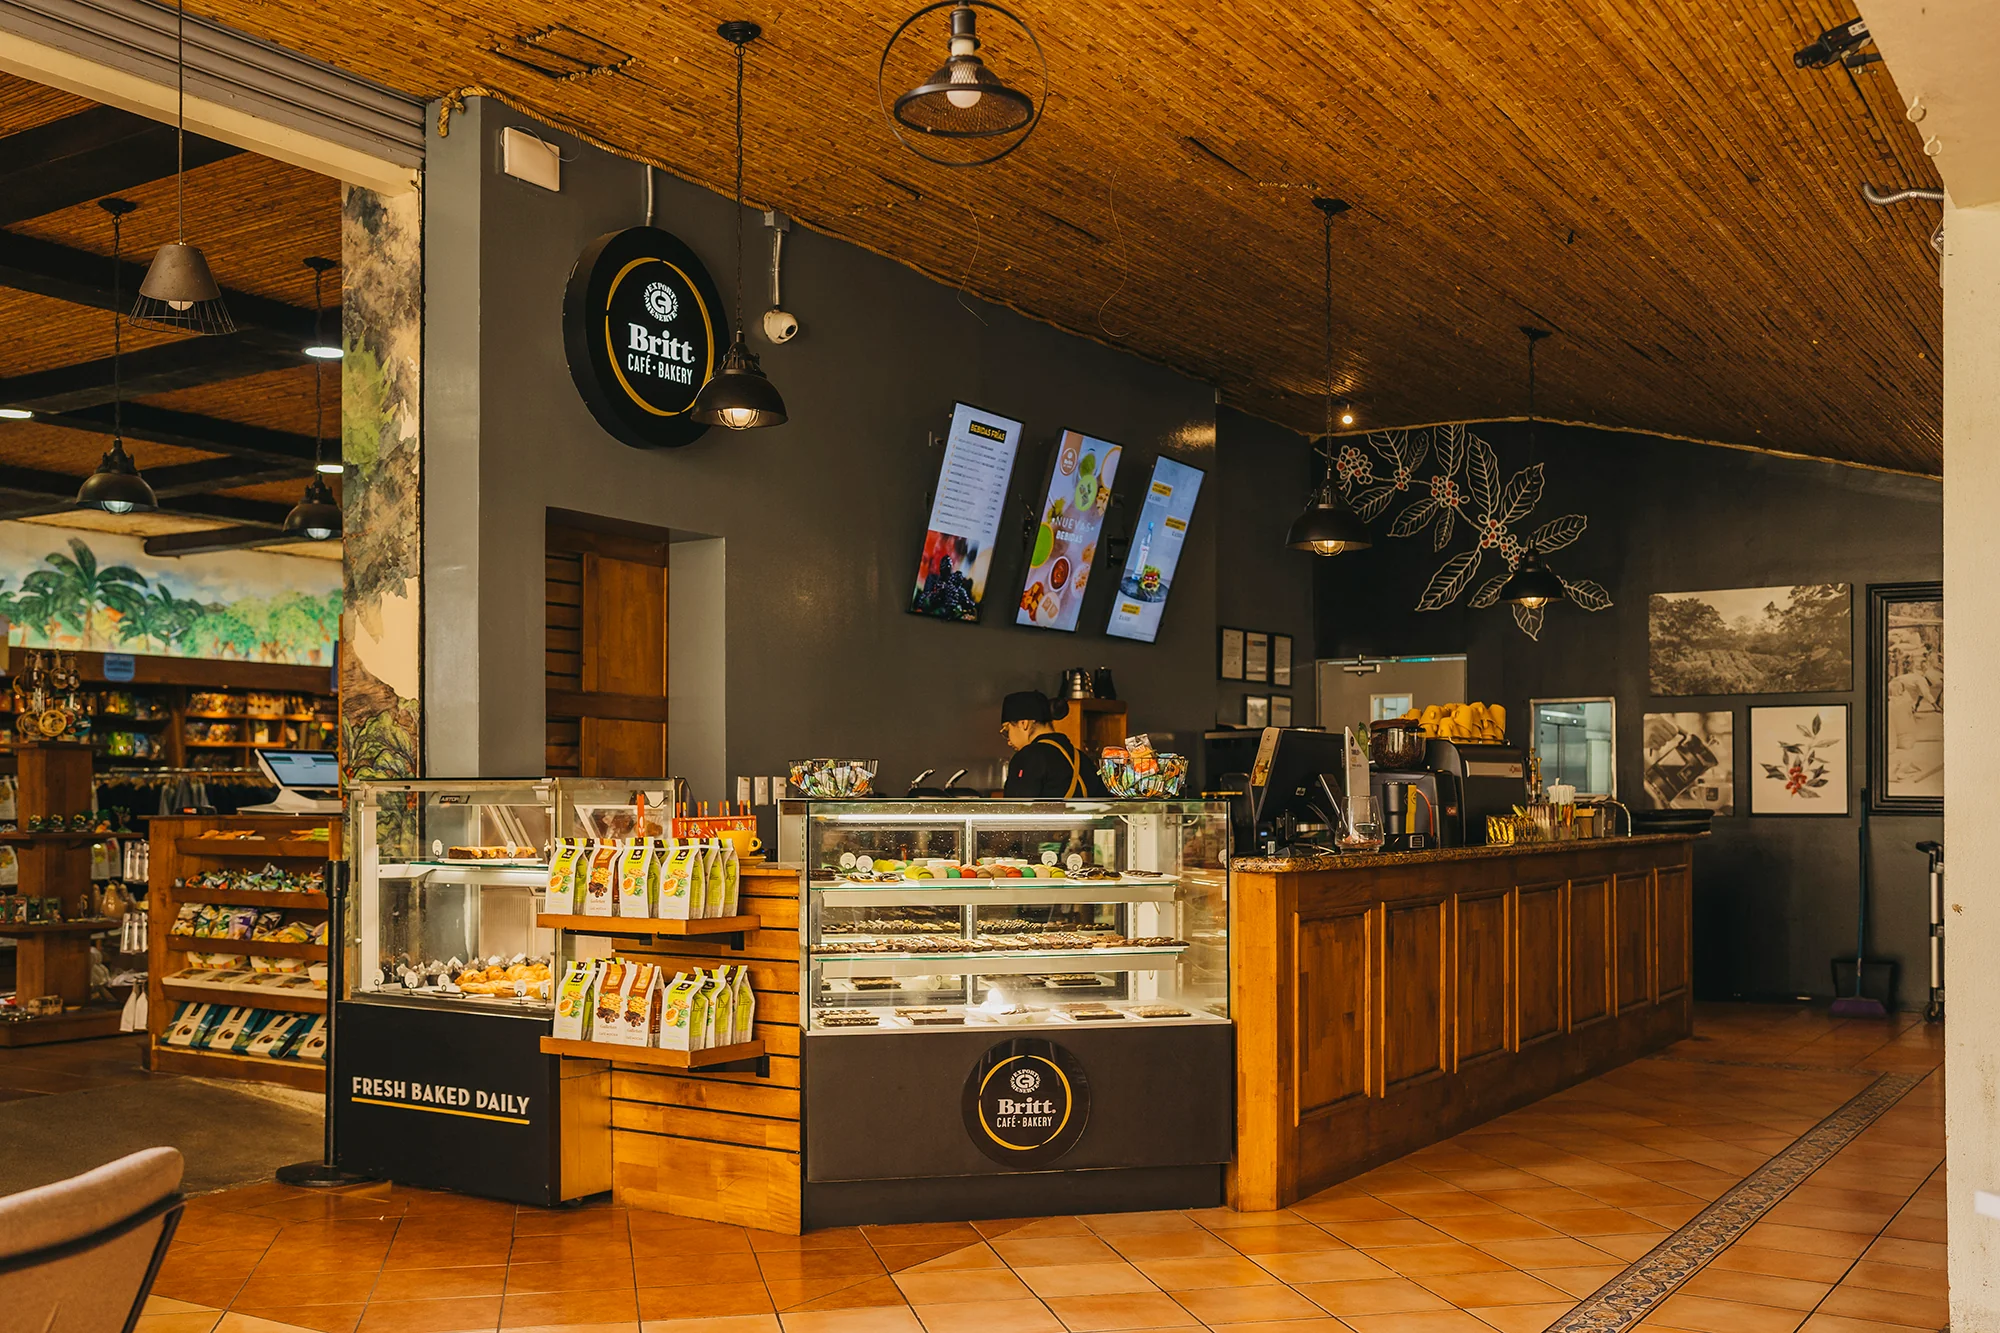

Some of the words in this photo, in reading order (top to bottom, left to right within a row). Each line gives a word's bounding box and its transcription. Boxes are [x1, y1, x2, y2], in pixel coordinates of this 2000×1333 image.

[647, 282, 677, 299] EXPORT
[645, 303, 678, 322] RESERVE
[627, 353, 651, 376] CAFÉ
[658, 361, 693, 385] BAKERY
[970, 423, 991, 437] BEBIDAS
[1056, 530, 1083, 544] BEBIDAS
[352, 1075, 406, 1099] FRESH
[411, 1083, 470, 1108] BAKED
[476, 1090, 530, 1116] DAILY
[997, 1115, 1016, 1128] CAFÉ
[1023, 1116, 1052, 1128] BAKERY
